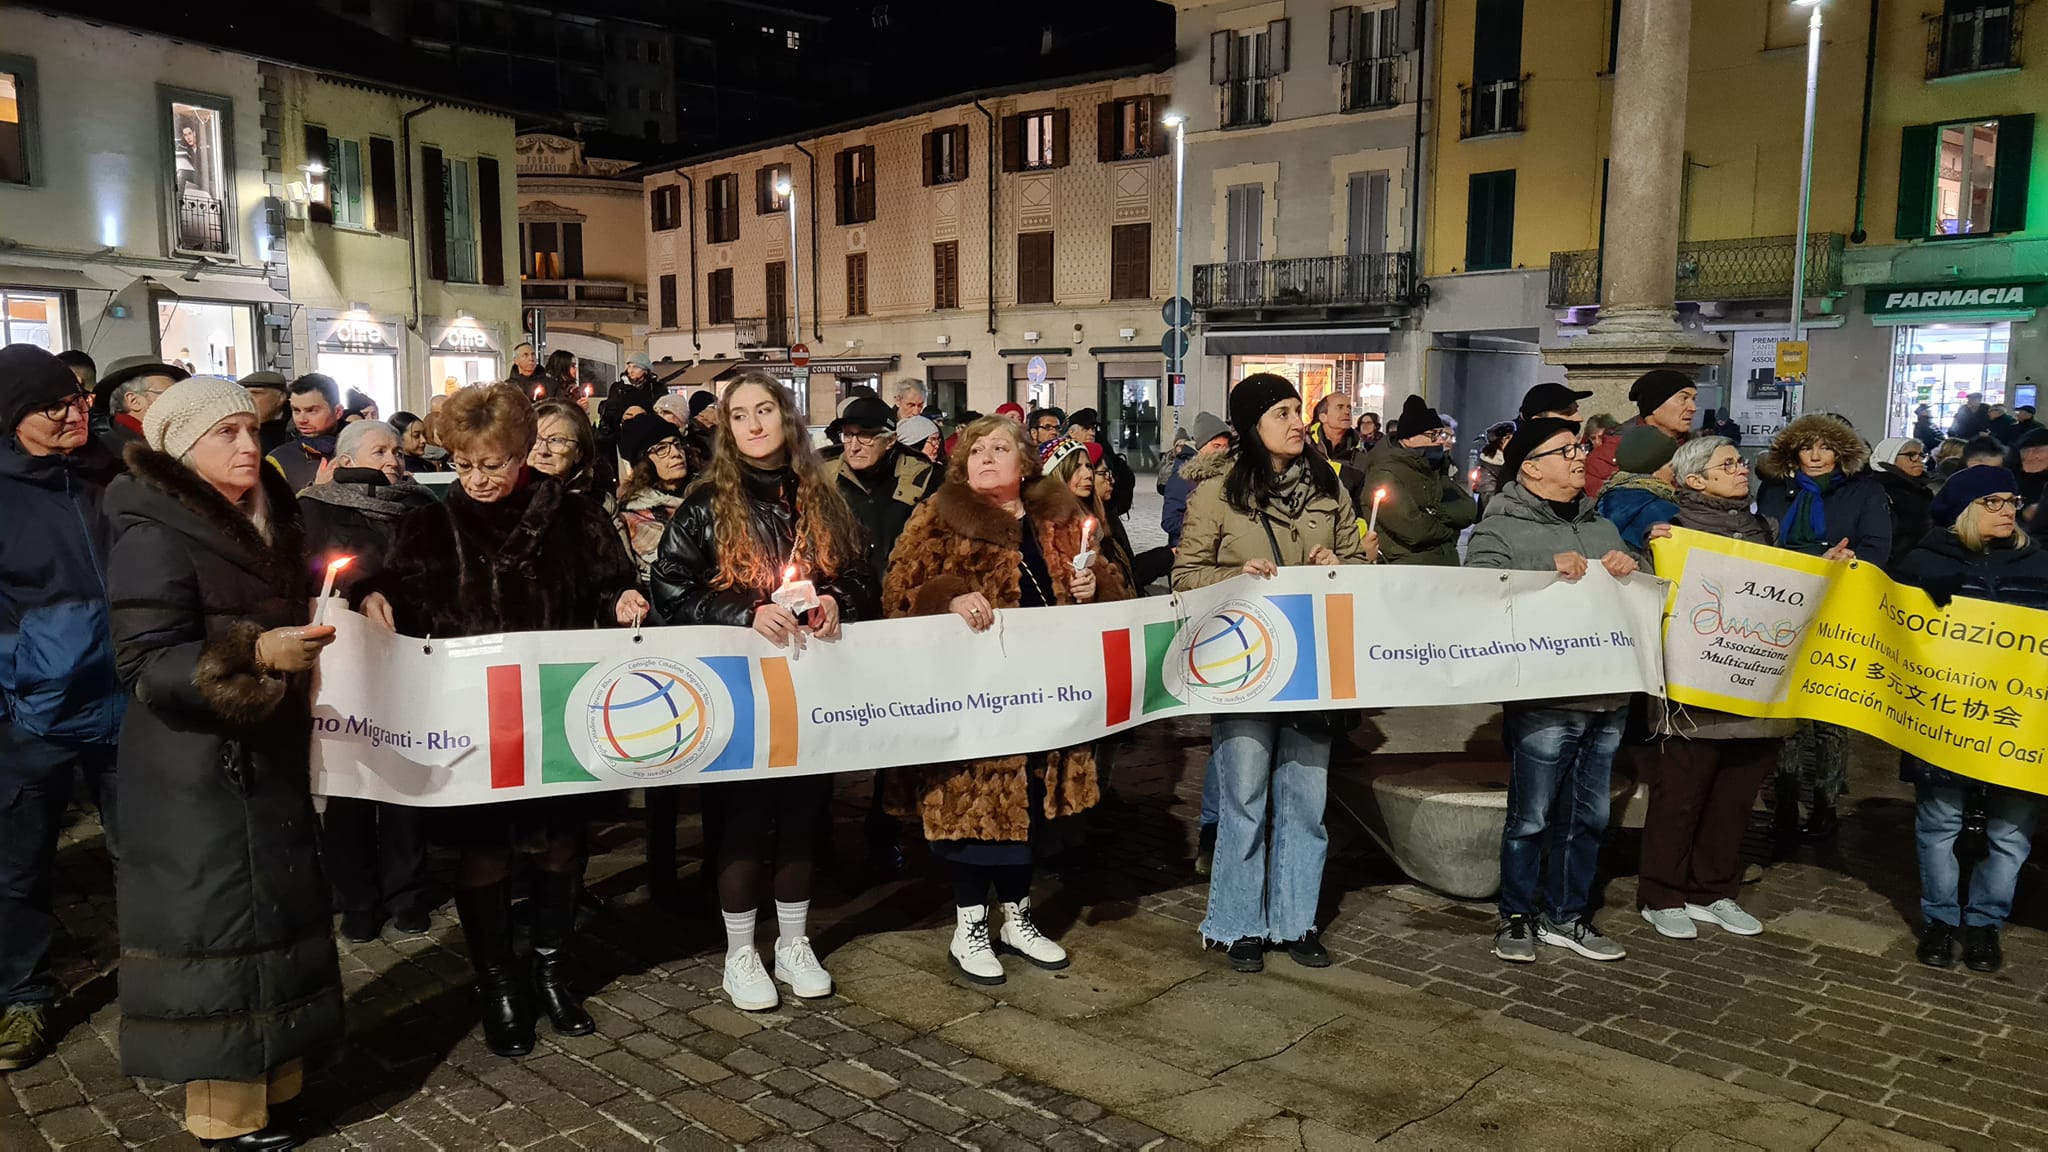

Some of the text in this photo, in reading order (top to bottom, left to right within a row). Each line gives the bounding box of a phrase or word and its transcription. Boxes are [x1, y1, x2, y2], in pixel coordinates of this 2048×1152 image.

[1885, 287, 2024, 309] FARMACIA
[812, 365, 858, 373] CONTINENTAL
[1738, 424, 1780, 435] LIERA
[1735, 581, 1805, 607] A.M.O.
[1878, 592, 2048, 656] Associazione
[1369, 643, 1446, 665] Consiglio
[1449, 640, 1526, 659] Cittadino
[1529, 632, 1601, 656] Migranti
[1709, 636, 1790, 661] Associazione
[1730, 673, 1757, 687] Oasi
[1810, 650, 2023, 728] OASI 多元文化协会
[811, 704, 887, 726] Consiglio
[888, 697, 963, 718] Cittadino
[966, 688, 1043, 713] Migranti
[1057, 685, 1093, 702] Rho
[345, 714, 412, 748] Migranti
[427, 730, 471, 750] Rho
[1800, 677, 2045, 764] Asociación multicultural Oasi
